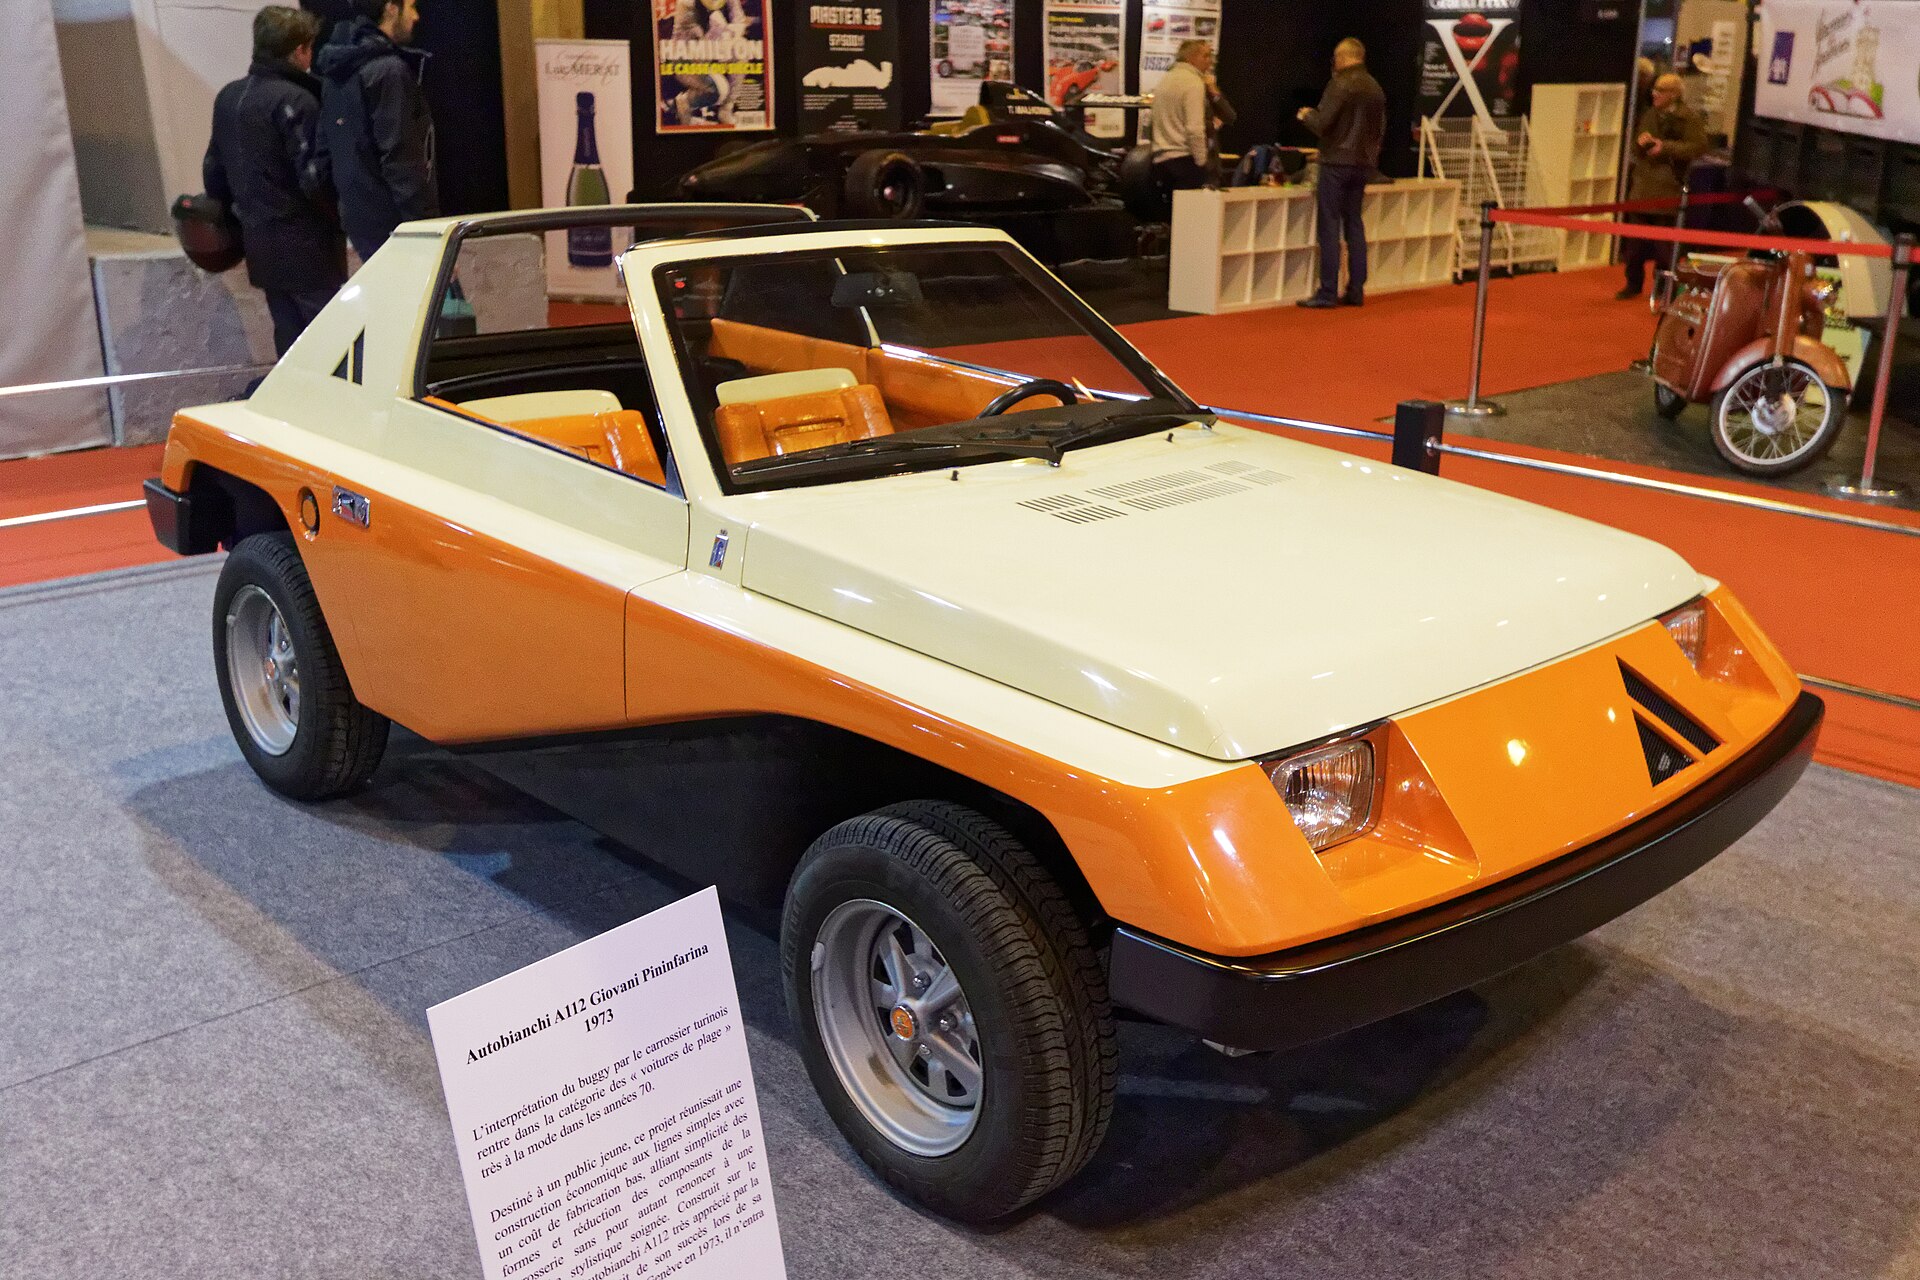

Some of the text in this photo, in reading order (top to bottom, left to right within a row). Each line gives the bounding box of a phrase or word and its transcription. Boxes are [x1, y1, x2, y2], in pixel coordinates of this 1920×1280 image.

[659, 39, 763, 61] HAMILTON
[810, 6, 882, 25] MASTER 35
[467, 945, 709, 1065] Autobianchi A112 Giovani Pininfarina
[562, 1084, 576, 1097] du
[578, 1066, 610, 1088] buggy
[614, 1056, 630, 1074] par
[633, 1050, 643, 1061] le
[646, 1026, 691, 1055] carrossier
[694, 1006, 728, 1030] turinois
[585, 1008, 614, 1033] 1973
[477, 1137, 510, 1160] rentre
[515, 1122, 540, 1141] dans
[544, 1114, 555, 1126] la
[559, 1088, 606, 1118] catégorie
[610, 1078, 627, 1092] des
[641, 1051, 679, 1075] voitures
[683, 1043, 694, 1055] de
[697, 1029, 722, 1050] plage
[481, 1081, 655, 1179] très à la mode dans les années 70.
[490, 1080, 741, 1223] Destiné à un public jeune, ce projet réunissait une
[495, 1097, 744, 1241] construction économique aux lignes simples avec
[498, 1113, 748, 1259] un coût de fabrication bas, alliant simplicité des
[503, 1129, 751, 1278] formes et réduction des composants de la
[523, 1146, 753, 1280] osserie sans pour autant renoncer à une
[571, 1161, 756, 1278] stylistique soignée. Construit sur le
[637, 1194, 762, 1276] de son succès lors de sa
[644, 1230, 669, 1253] A112
[673, 1220, 690, 1235] très
[693, 1192, 730, 1223] apprécié
[733, 1184, 748, 1201] par
[750, 1178, 759, 1188] la
[685, 1253, 696, 1265] en
[699, 1235, 724, 1256] 1973,
[725, 1227, 732, 1239] il
